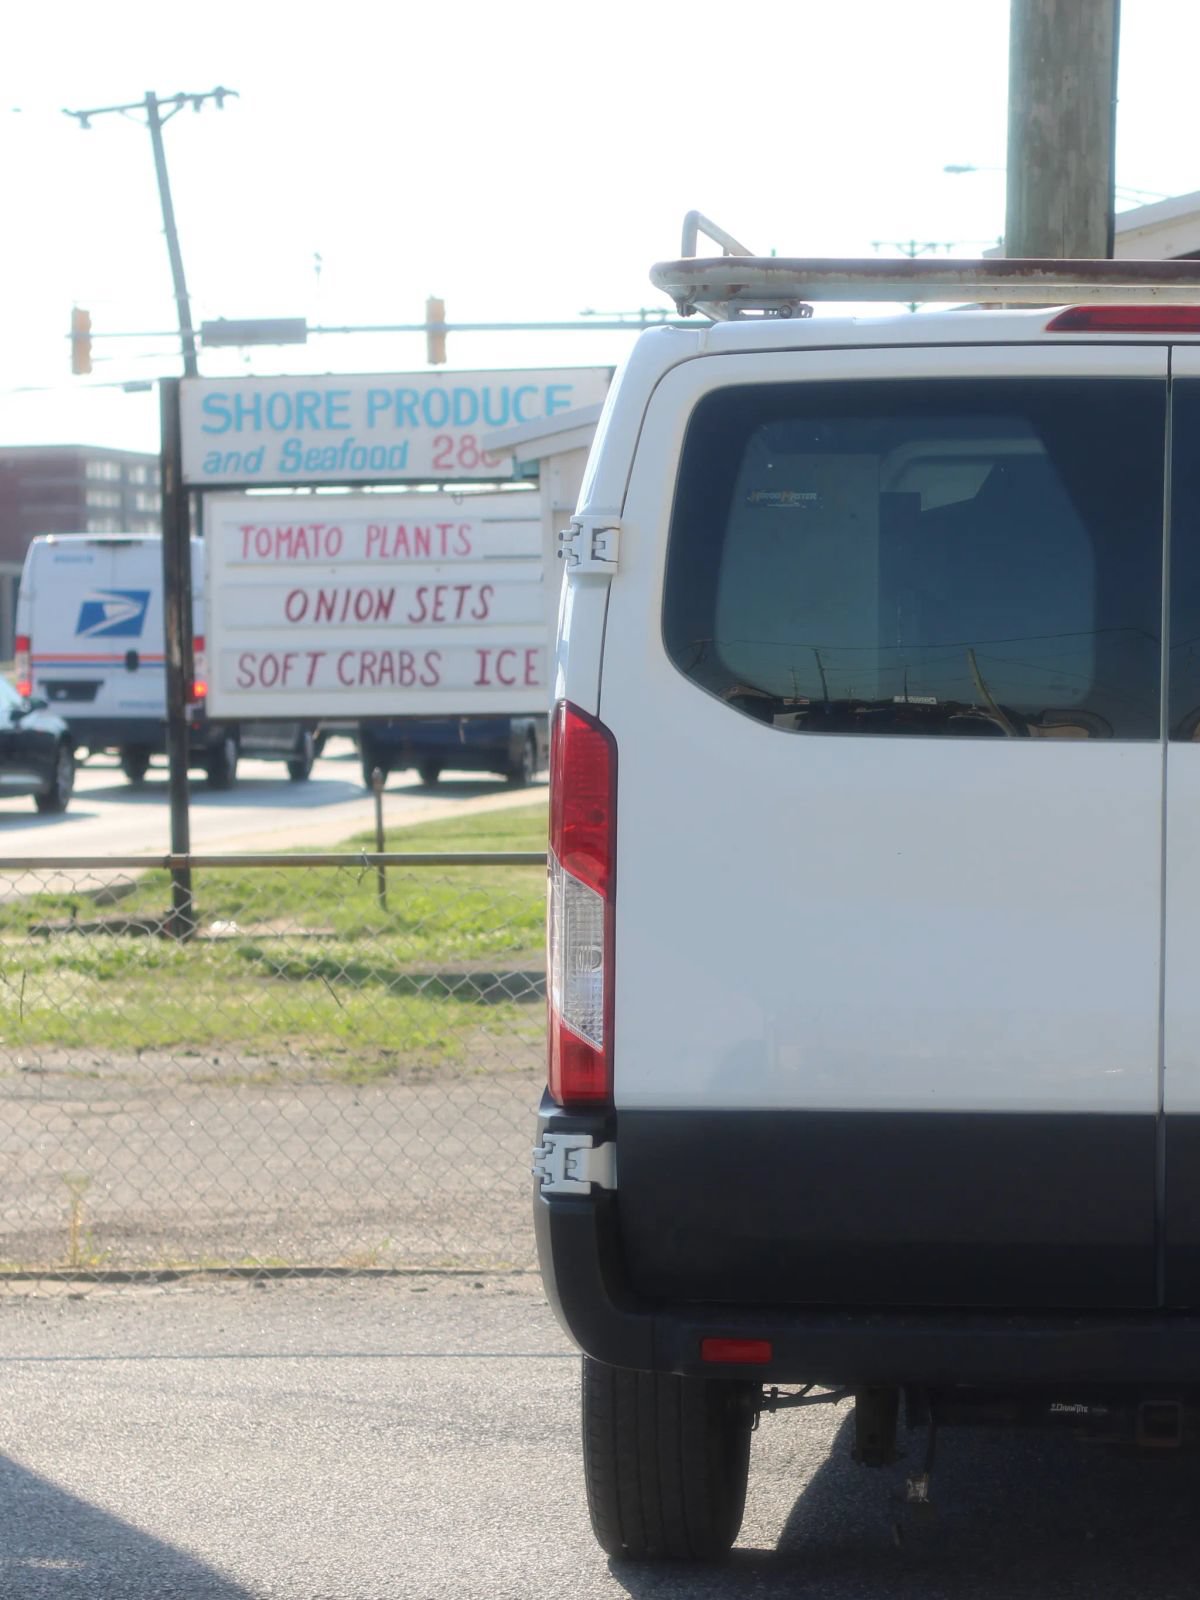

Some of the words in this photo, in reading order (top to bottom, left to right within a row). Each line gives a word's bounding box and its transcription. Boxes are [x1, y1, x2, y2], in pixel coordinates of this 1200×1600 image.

[201, 389, 352, 434] SHORE
[366, 384, 574, 429] PRODUCE
[202, 444, 266, 474] and
[278, 437, 410, 473] Seafood
[240, 524, 343, 559] TOMATO
[365, 523, 472, 558] PLANTS
[285, 588, 396, 622] ONION
[408, 585, 494, 623] SETS
[236, 651, 327, 688] SOFT
[337, 650, 441, 687] CRABS
[474, 648, 540, 686] ICE
